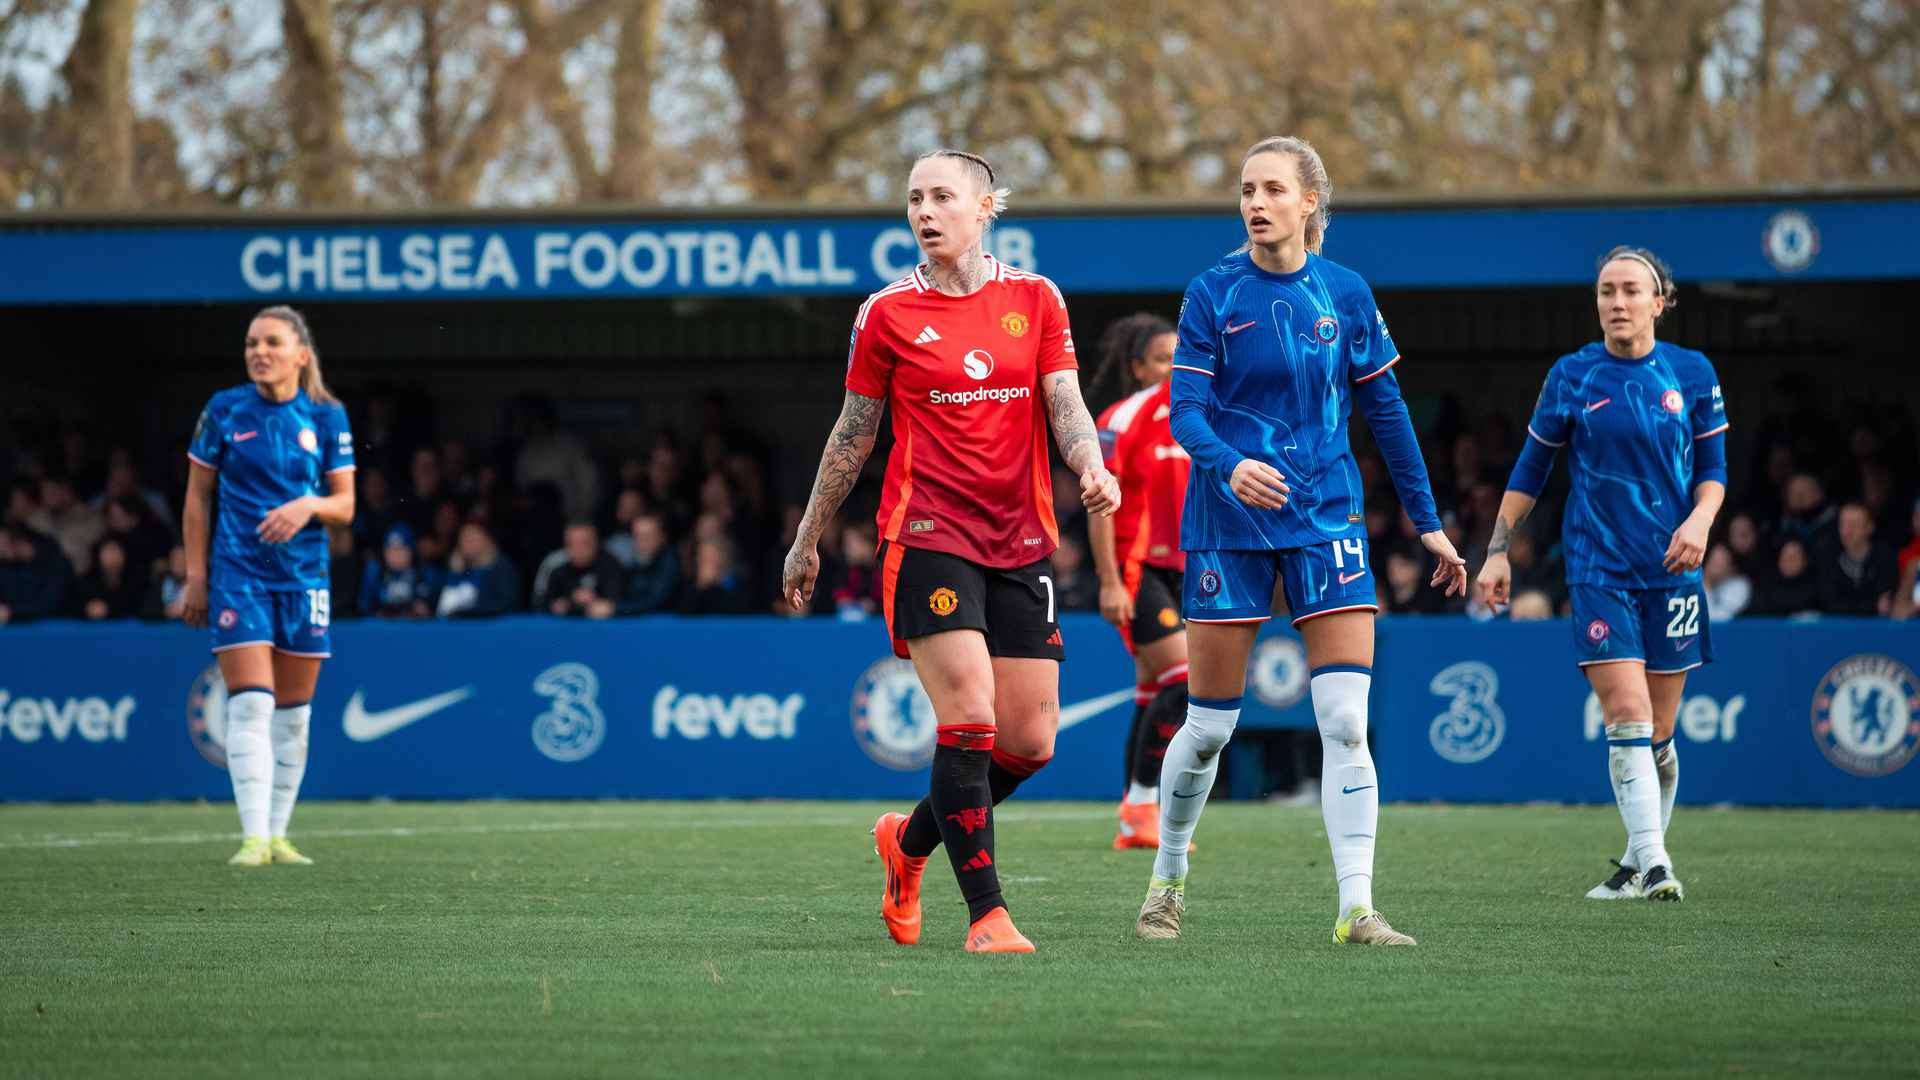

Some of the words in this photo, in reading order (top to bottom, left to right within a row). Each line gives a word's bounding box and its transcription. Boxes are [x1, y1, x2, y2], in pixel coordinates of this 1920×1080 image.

[241, 236, 518, 292] CHELSEA
[534, 232, 854, 288] FOOTBALL
[871, 227, 1038, 284] CB
[929, 386, 1030, 406] Snapdragon
[1332, 538, 1366, 568] 14
[306, 589, 330, 626] 19
[1666, 594, 1699, 637] 22
[652, 685, 804, 740] fever
[1583, 690, 1746, 742] fer
